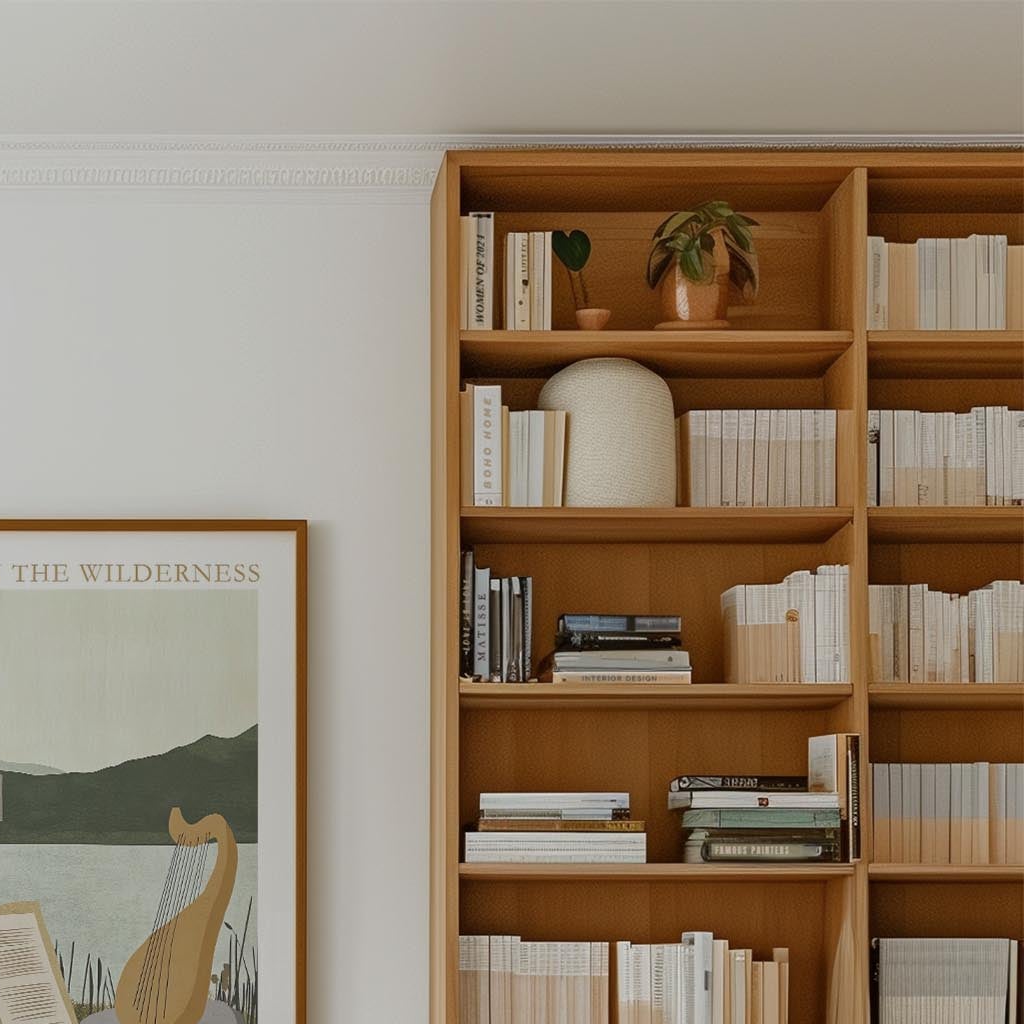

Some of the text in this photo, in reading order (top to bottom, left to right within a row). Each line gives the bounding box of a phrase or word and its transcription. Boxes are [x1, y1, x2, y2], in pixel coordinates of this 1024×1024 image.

[475, 234, 485, 324] WOMEN OF 2024
[484, 398, 492, 489] BOHO HOME
[12, 563, 69, 583] THE
[79, 563, 261, 583] WILDERNESS
[478, 593, 487, 661] MATISSE
[714, 845, 790, 855] FAMOUS PAINTERS
